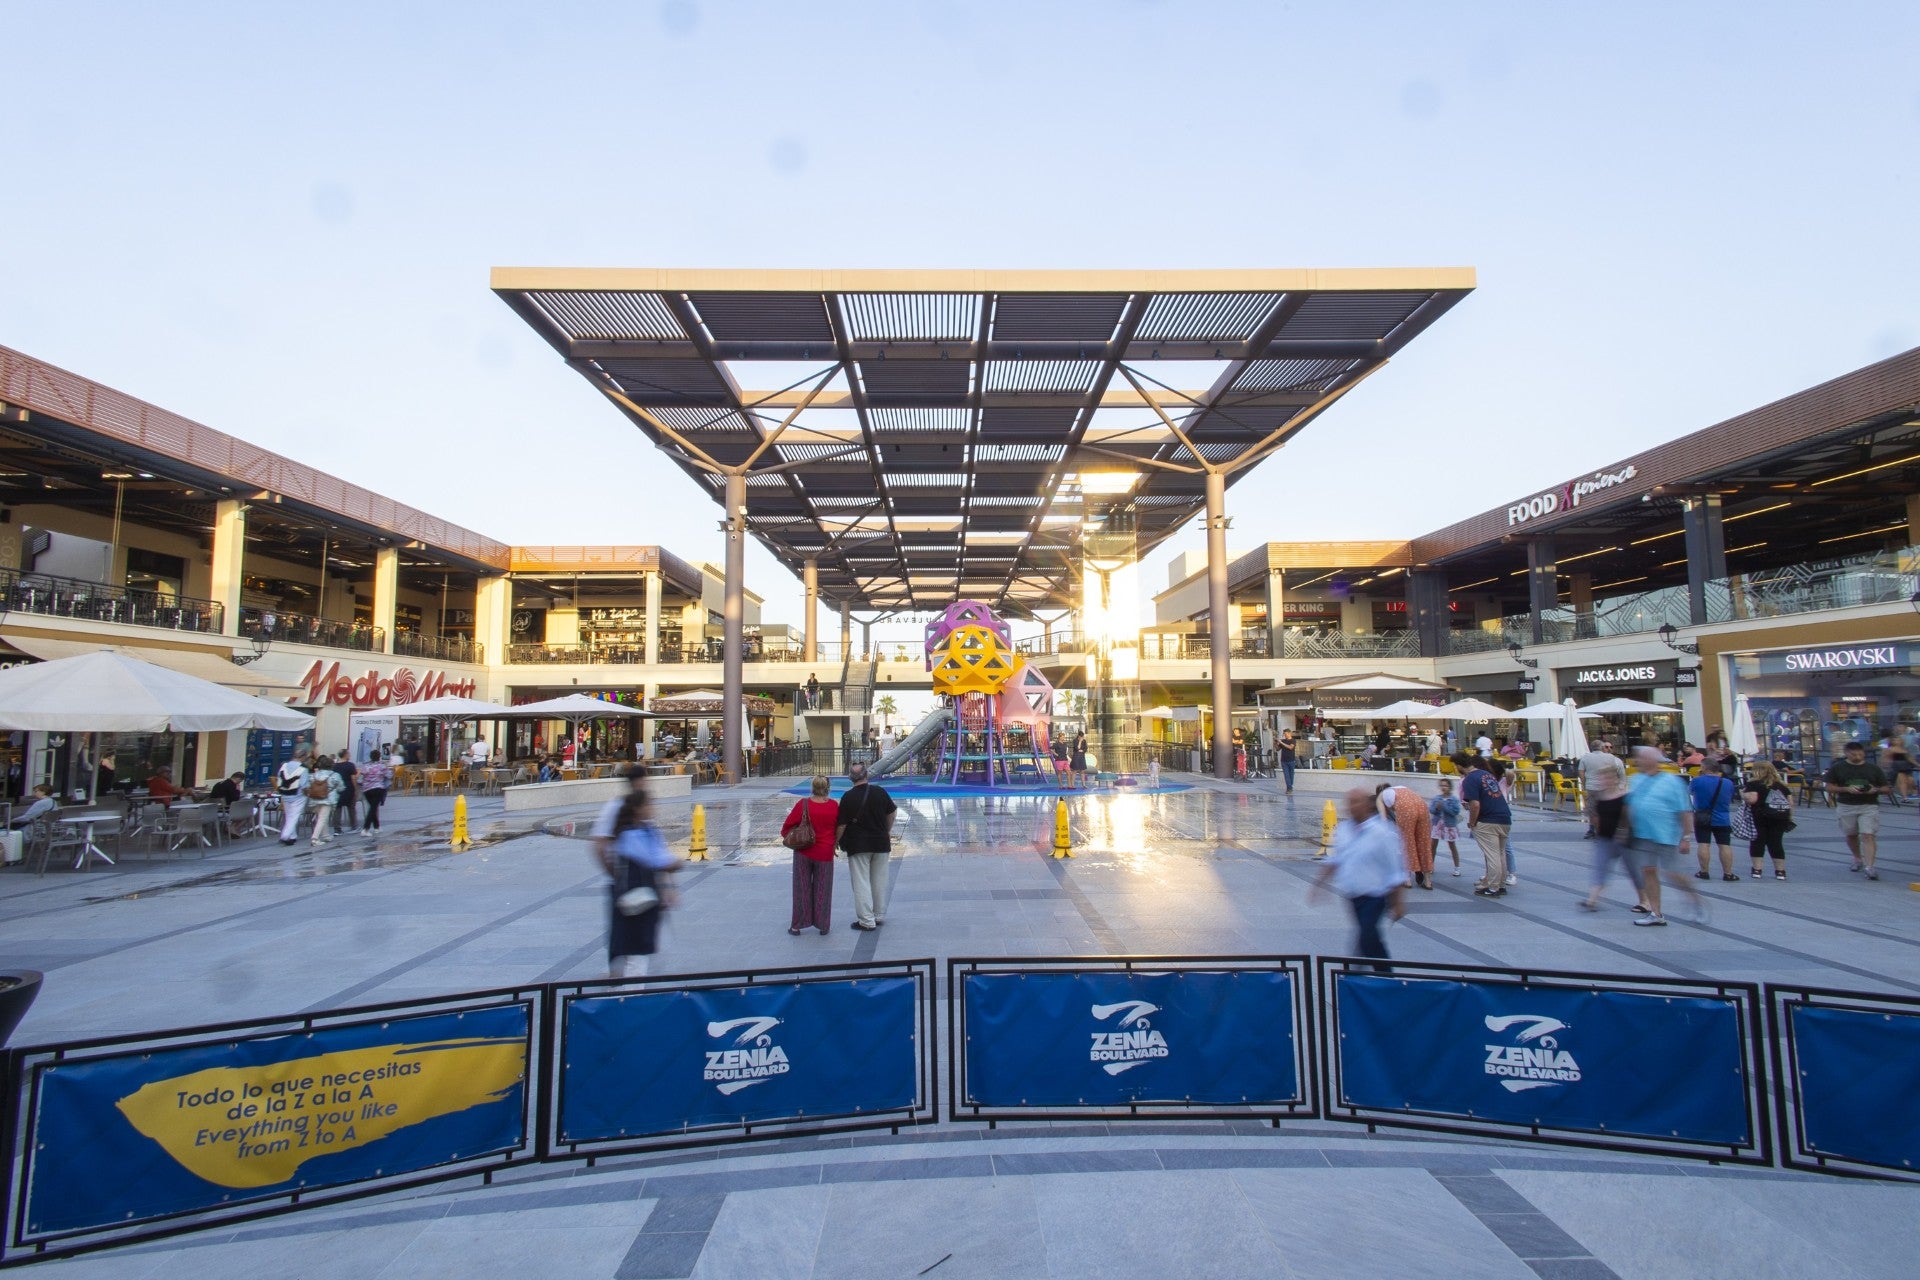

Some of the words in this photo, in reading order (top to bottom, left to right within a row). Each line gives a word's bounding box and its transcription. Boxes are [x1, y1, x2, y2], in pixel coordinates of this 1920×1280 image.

[1508, 493, 1558, 526] FOOD
[455, 611, 474, 623] Pa
[1256, 604, 1297, 612] BUER
[1299, 604, 1325, 612] KING
[1785, 647, 1895, 670] SWAROVSKI
[288, 660, 394, 706] Media
[413, 670, 476, 704] Markt
[1090, 1030, 1168, 1051] ZENIA
[704, 1046, 789, 1070] ZENIA
[1090, 1047, 1169, 1060] BOULEVARD
[1485, 1045, 1580, 1070] ZENIA
[704, 1063, 790, 1080] BOULEVARD
[1485, 1064, 1581, 1081] BOULEVARD
[177, 1087, 234, 1109] Todo
[242, 1082, 263, 1100] lo
[271, 1077, 314, 1098] que
[321, 1061, 422, 1088] necesitas
[227, 1104, 258, 1121] de
[266, 1097, 286, 1115] la
[293, 1093, 305, 1109] Z
[312, 1094, 326, 1106] a
[332, 1088, 351, 1104] la
[358, 1084, 374, 1100] A
[195, 1115, 308, 1147] Eveything
[316, 1108, 354, 1129] you
[361, 1102, 398, 1121] like
[237, 1136, 290, 1159] from
[298, 1131, 309, 1147] Z
[315, 1129, 335, 1145] to
[341, 1126, 357, 1142] A
